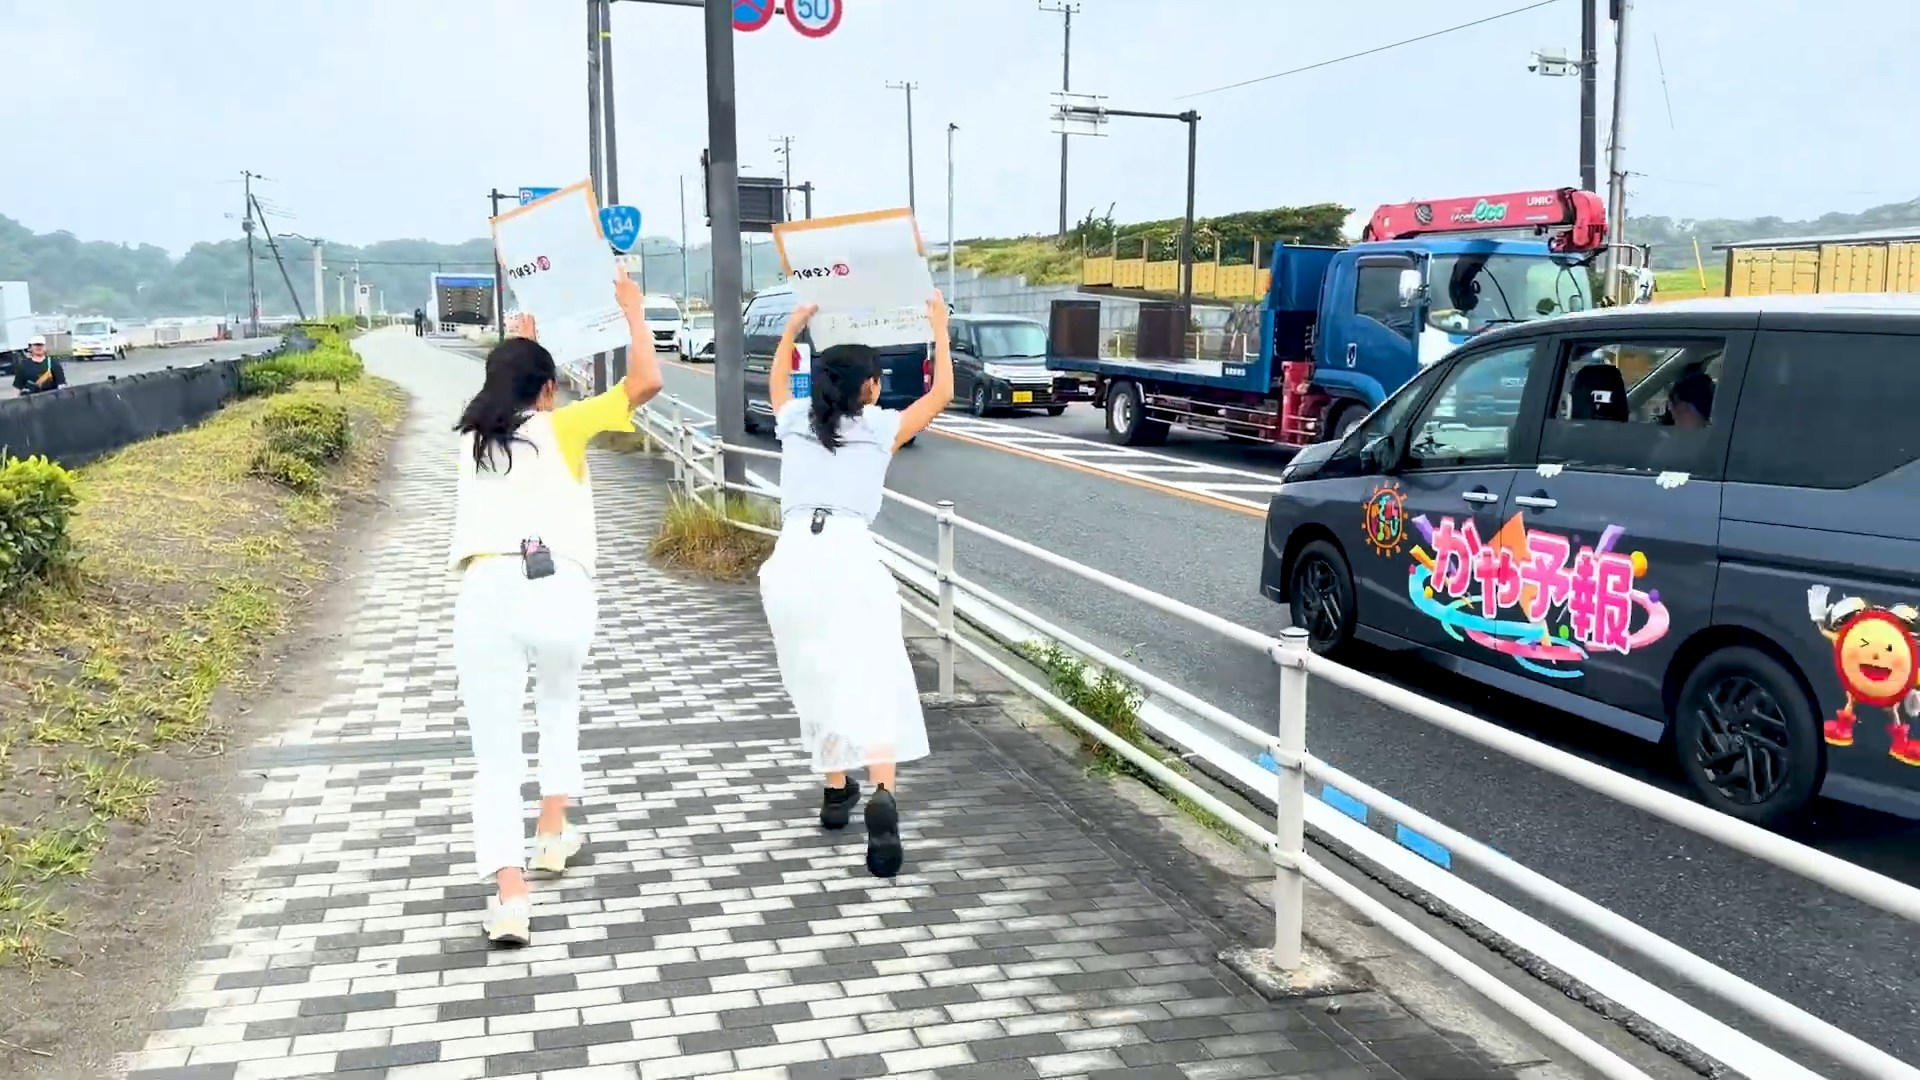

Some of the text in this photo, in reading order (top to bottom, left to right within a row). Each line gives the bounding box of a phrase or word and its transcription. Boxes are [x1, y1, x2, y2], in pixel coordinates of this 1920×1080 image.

[798, 0, 829, 20] 50
[1527, 196, 1553, 207] UNIC
[608, 216, 634, 235] 134
[1431, 516, 1633, 655] かや予報
